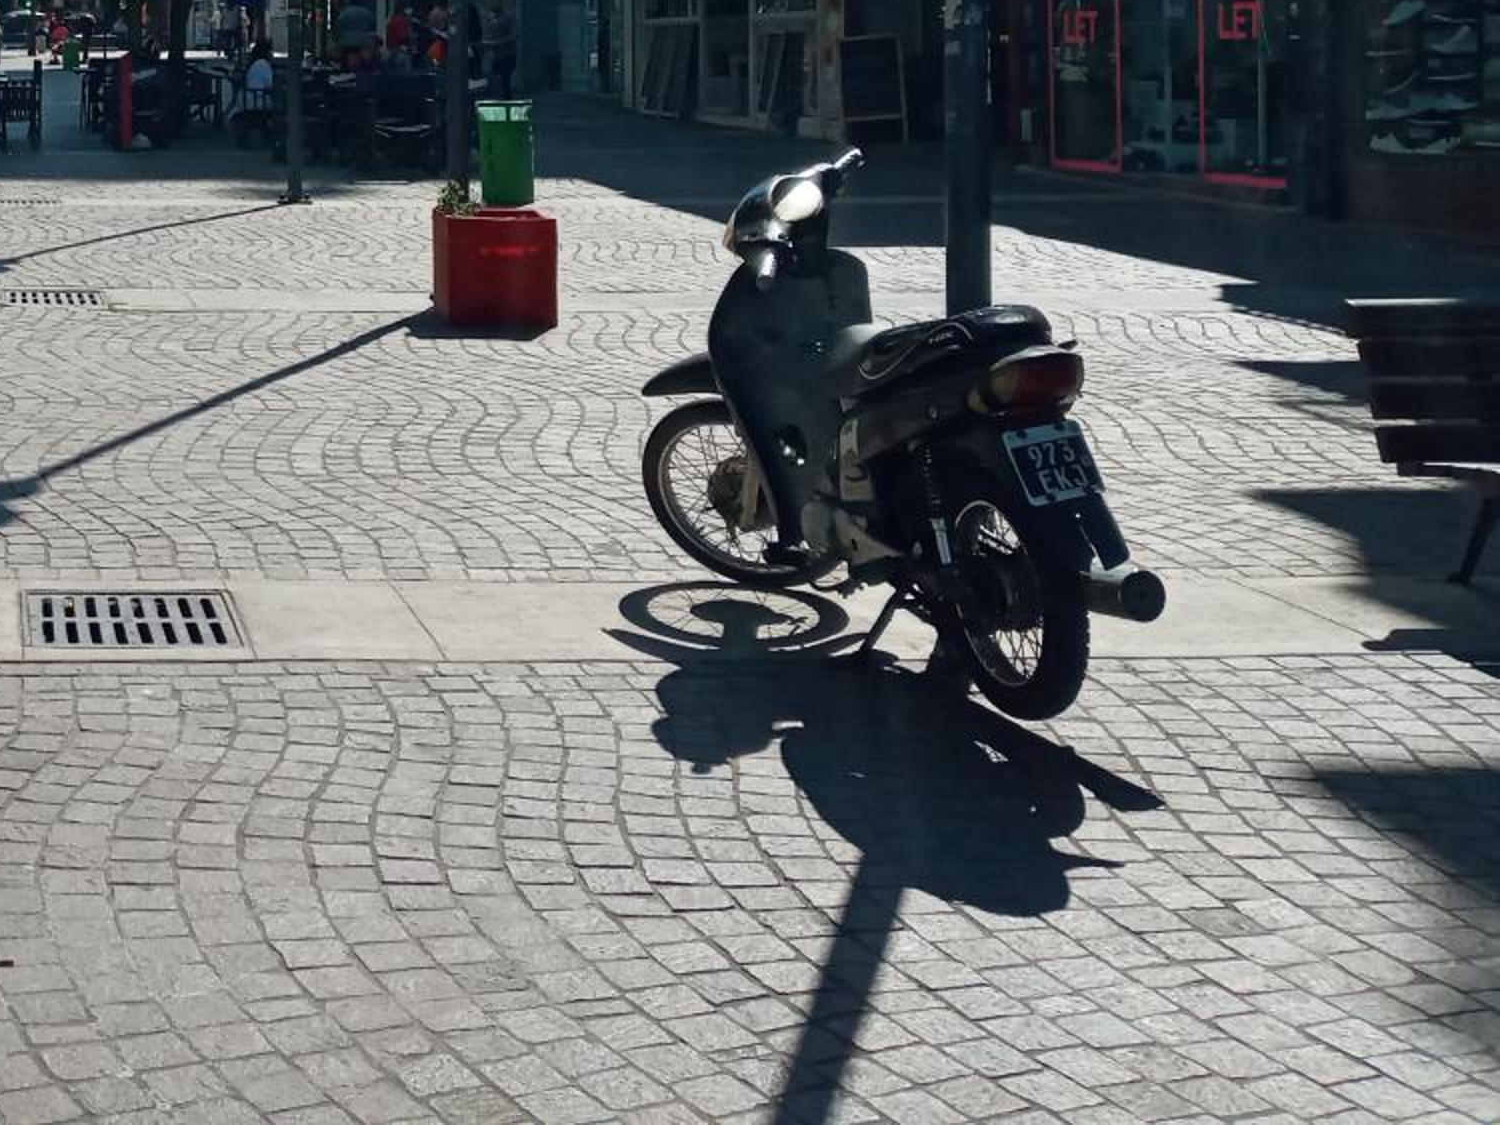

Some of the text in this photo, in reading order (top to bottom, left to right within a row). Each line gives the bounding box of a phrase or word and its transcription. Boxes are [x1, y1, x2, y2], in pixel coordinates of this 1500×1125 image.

[1063, 10, 1098, 44] LET
[1218, 0, 1262, 40] LET
[1027, 441, 1075, 469] 973
